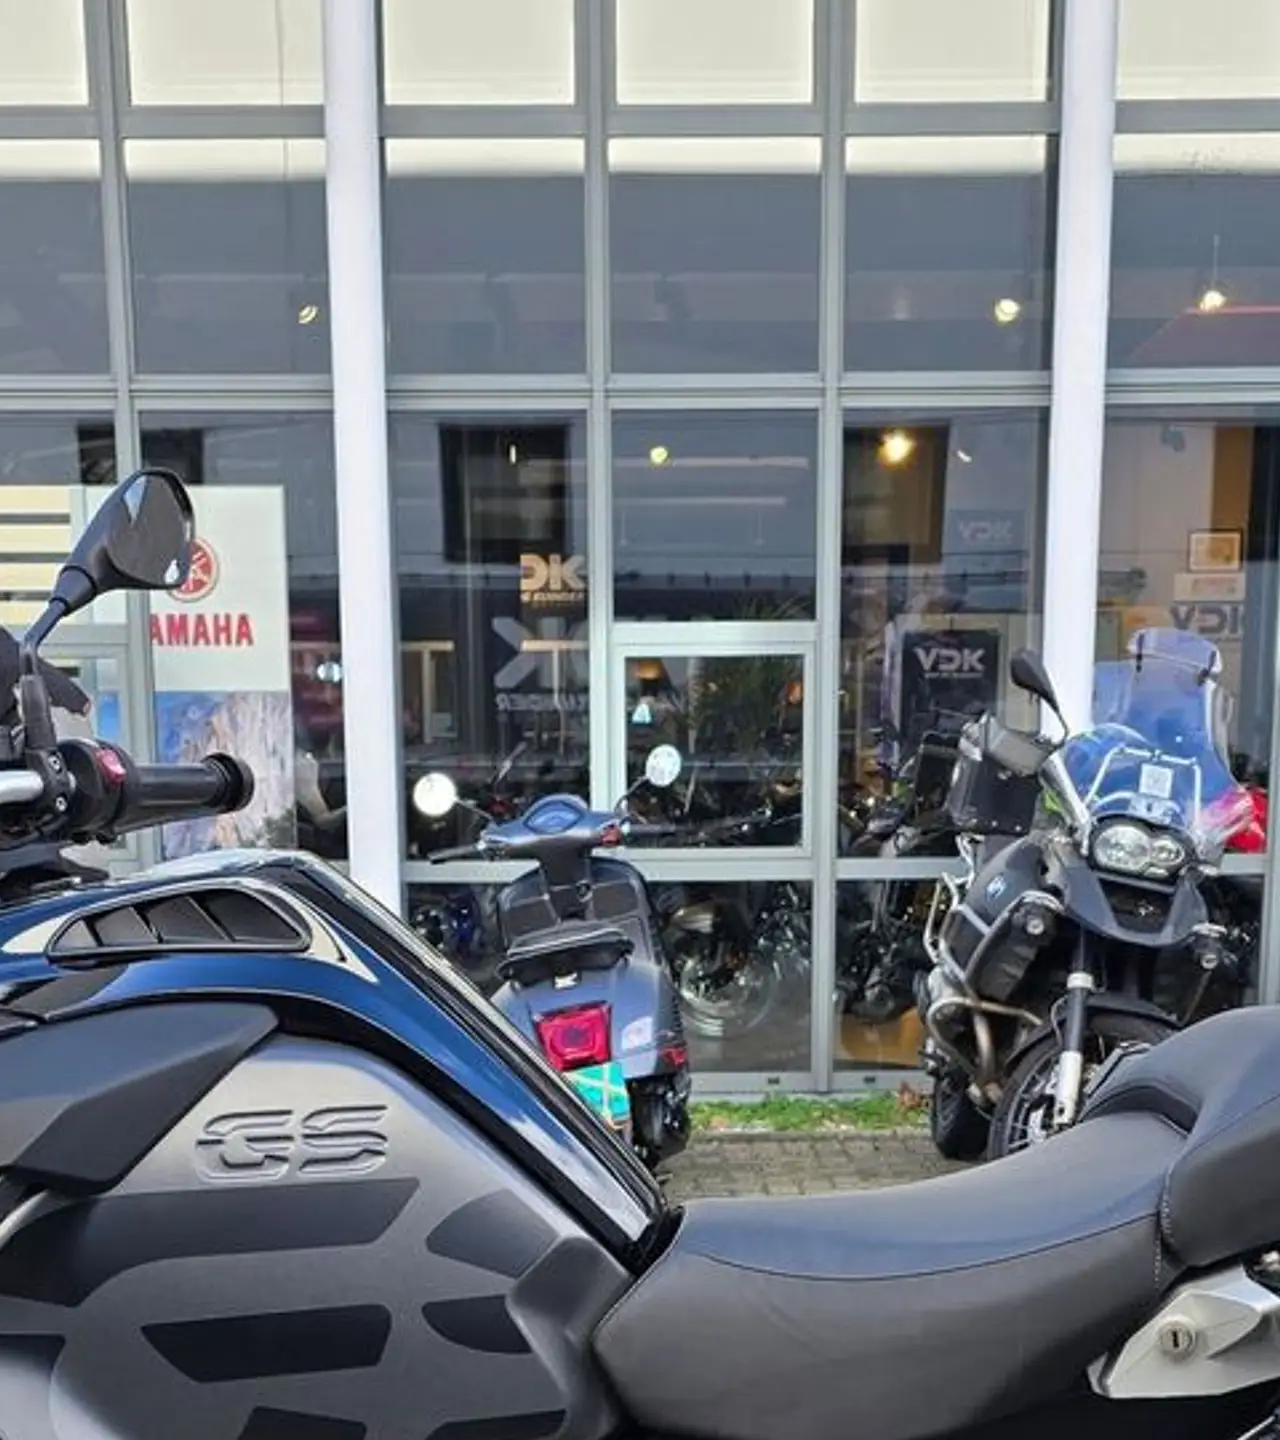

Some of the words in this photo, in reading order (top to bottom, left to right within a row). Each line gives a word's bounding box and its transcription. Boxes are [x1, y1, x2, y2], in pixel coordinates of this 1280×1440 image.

[520, 553, 586, 592] DK
[150, 612, 254, 646] AMAHA
[913, 647, 986, 672] VDK
[194, 1104, 389, 1184] GS
